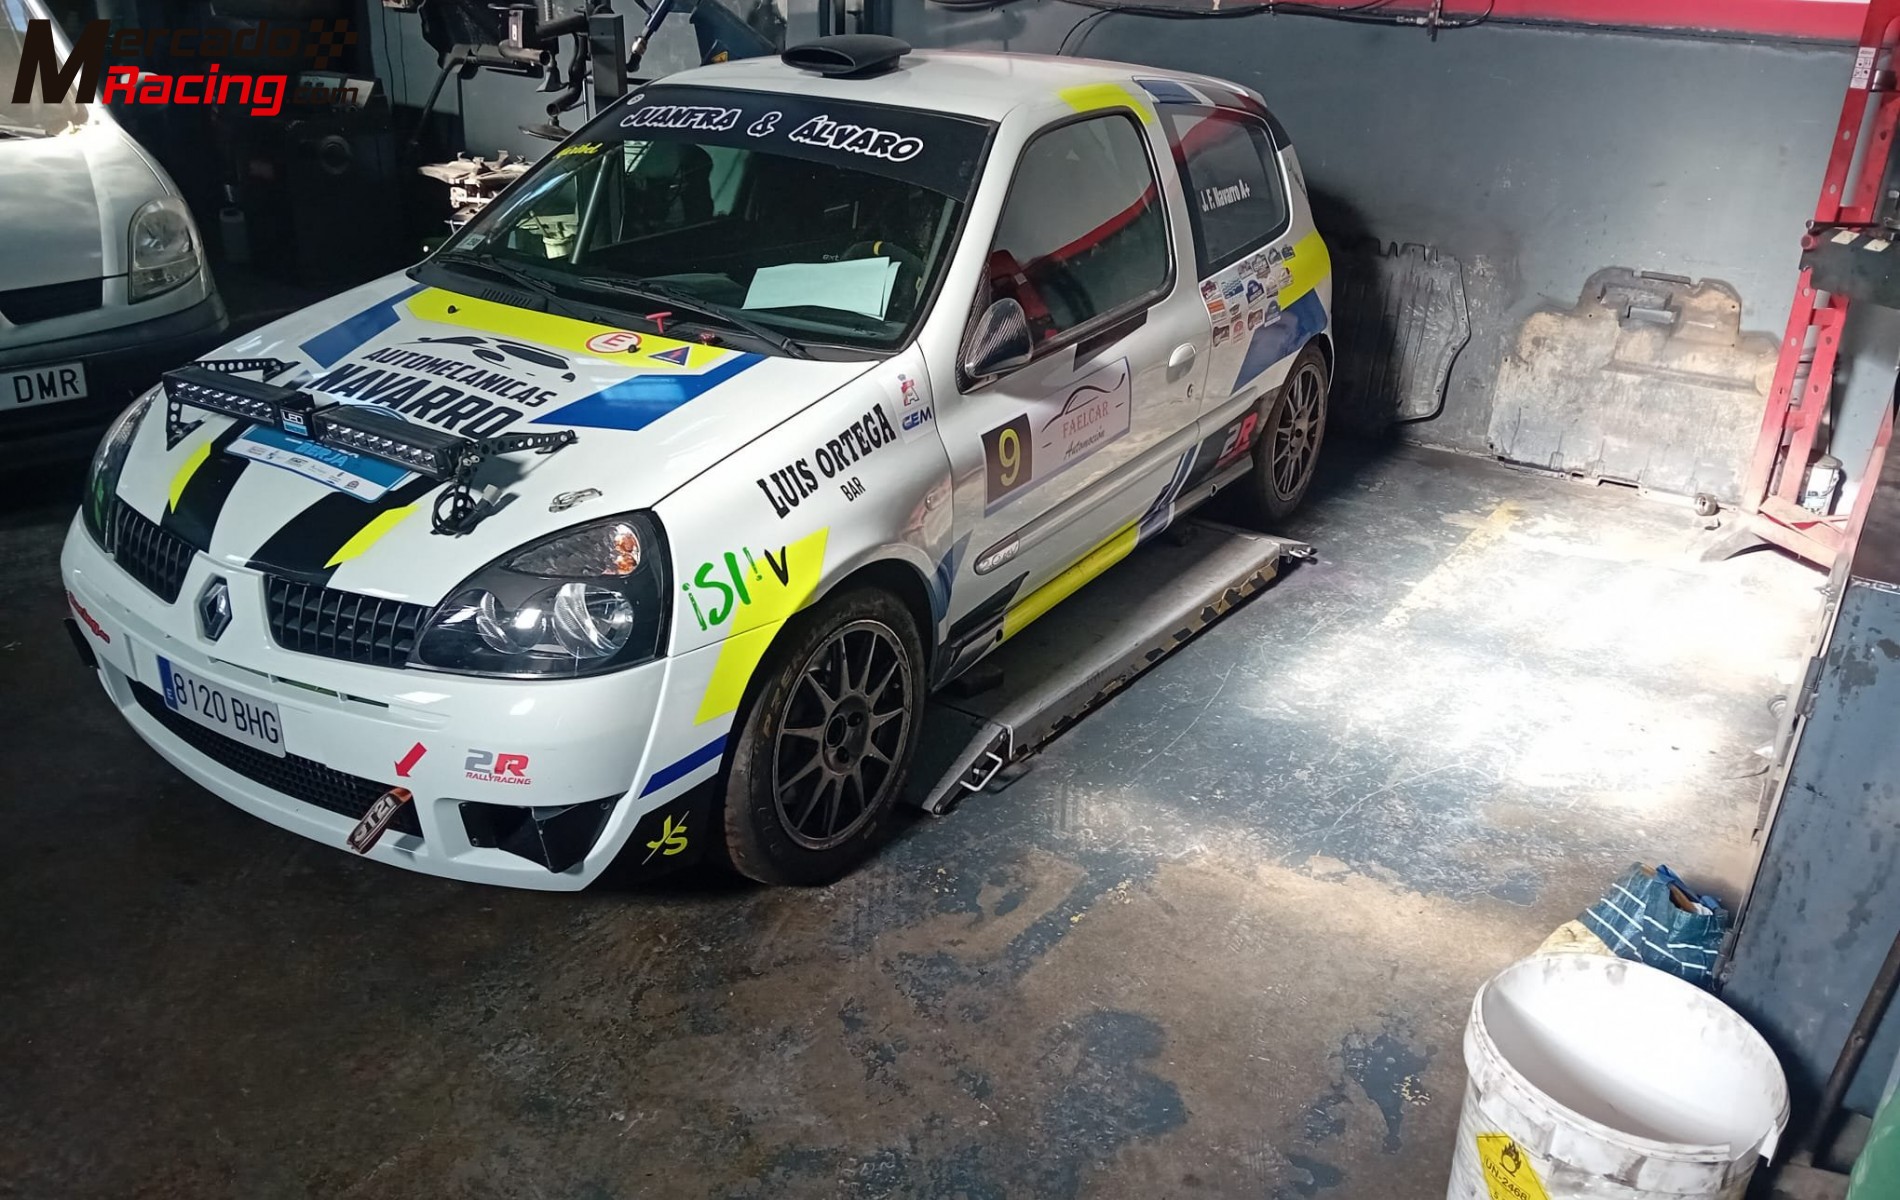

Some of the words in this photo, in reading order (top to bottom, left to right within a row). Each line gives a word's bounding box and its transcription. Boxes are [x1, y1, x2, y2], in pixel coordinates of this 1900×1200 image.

[620, 104, 742, 132] JUANFRA
[747, 111, 782, 137] &
[789, 114, 924, 162] ÁLVARO
[14, 368, 81, 404] DMR
[313, 363, 524, 438] NAVARRO
[363, 346, 559, 408] AUTOMECANICAS
[1062, 400, 1109, 439] FAELCAR
[756, 458, 820, 520] LUIS
[814, 402, 898, 479] ORTEGA
[998, 427, 1022, 488] 9
[839, 476, 866, 502] BAR
[173, 672, 228, 723] 8120
[230, 696, 280, 744] BHG
[464, 748, 529, 777] 2R
